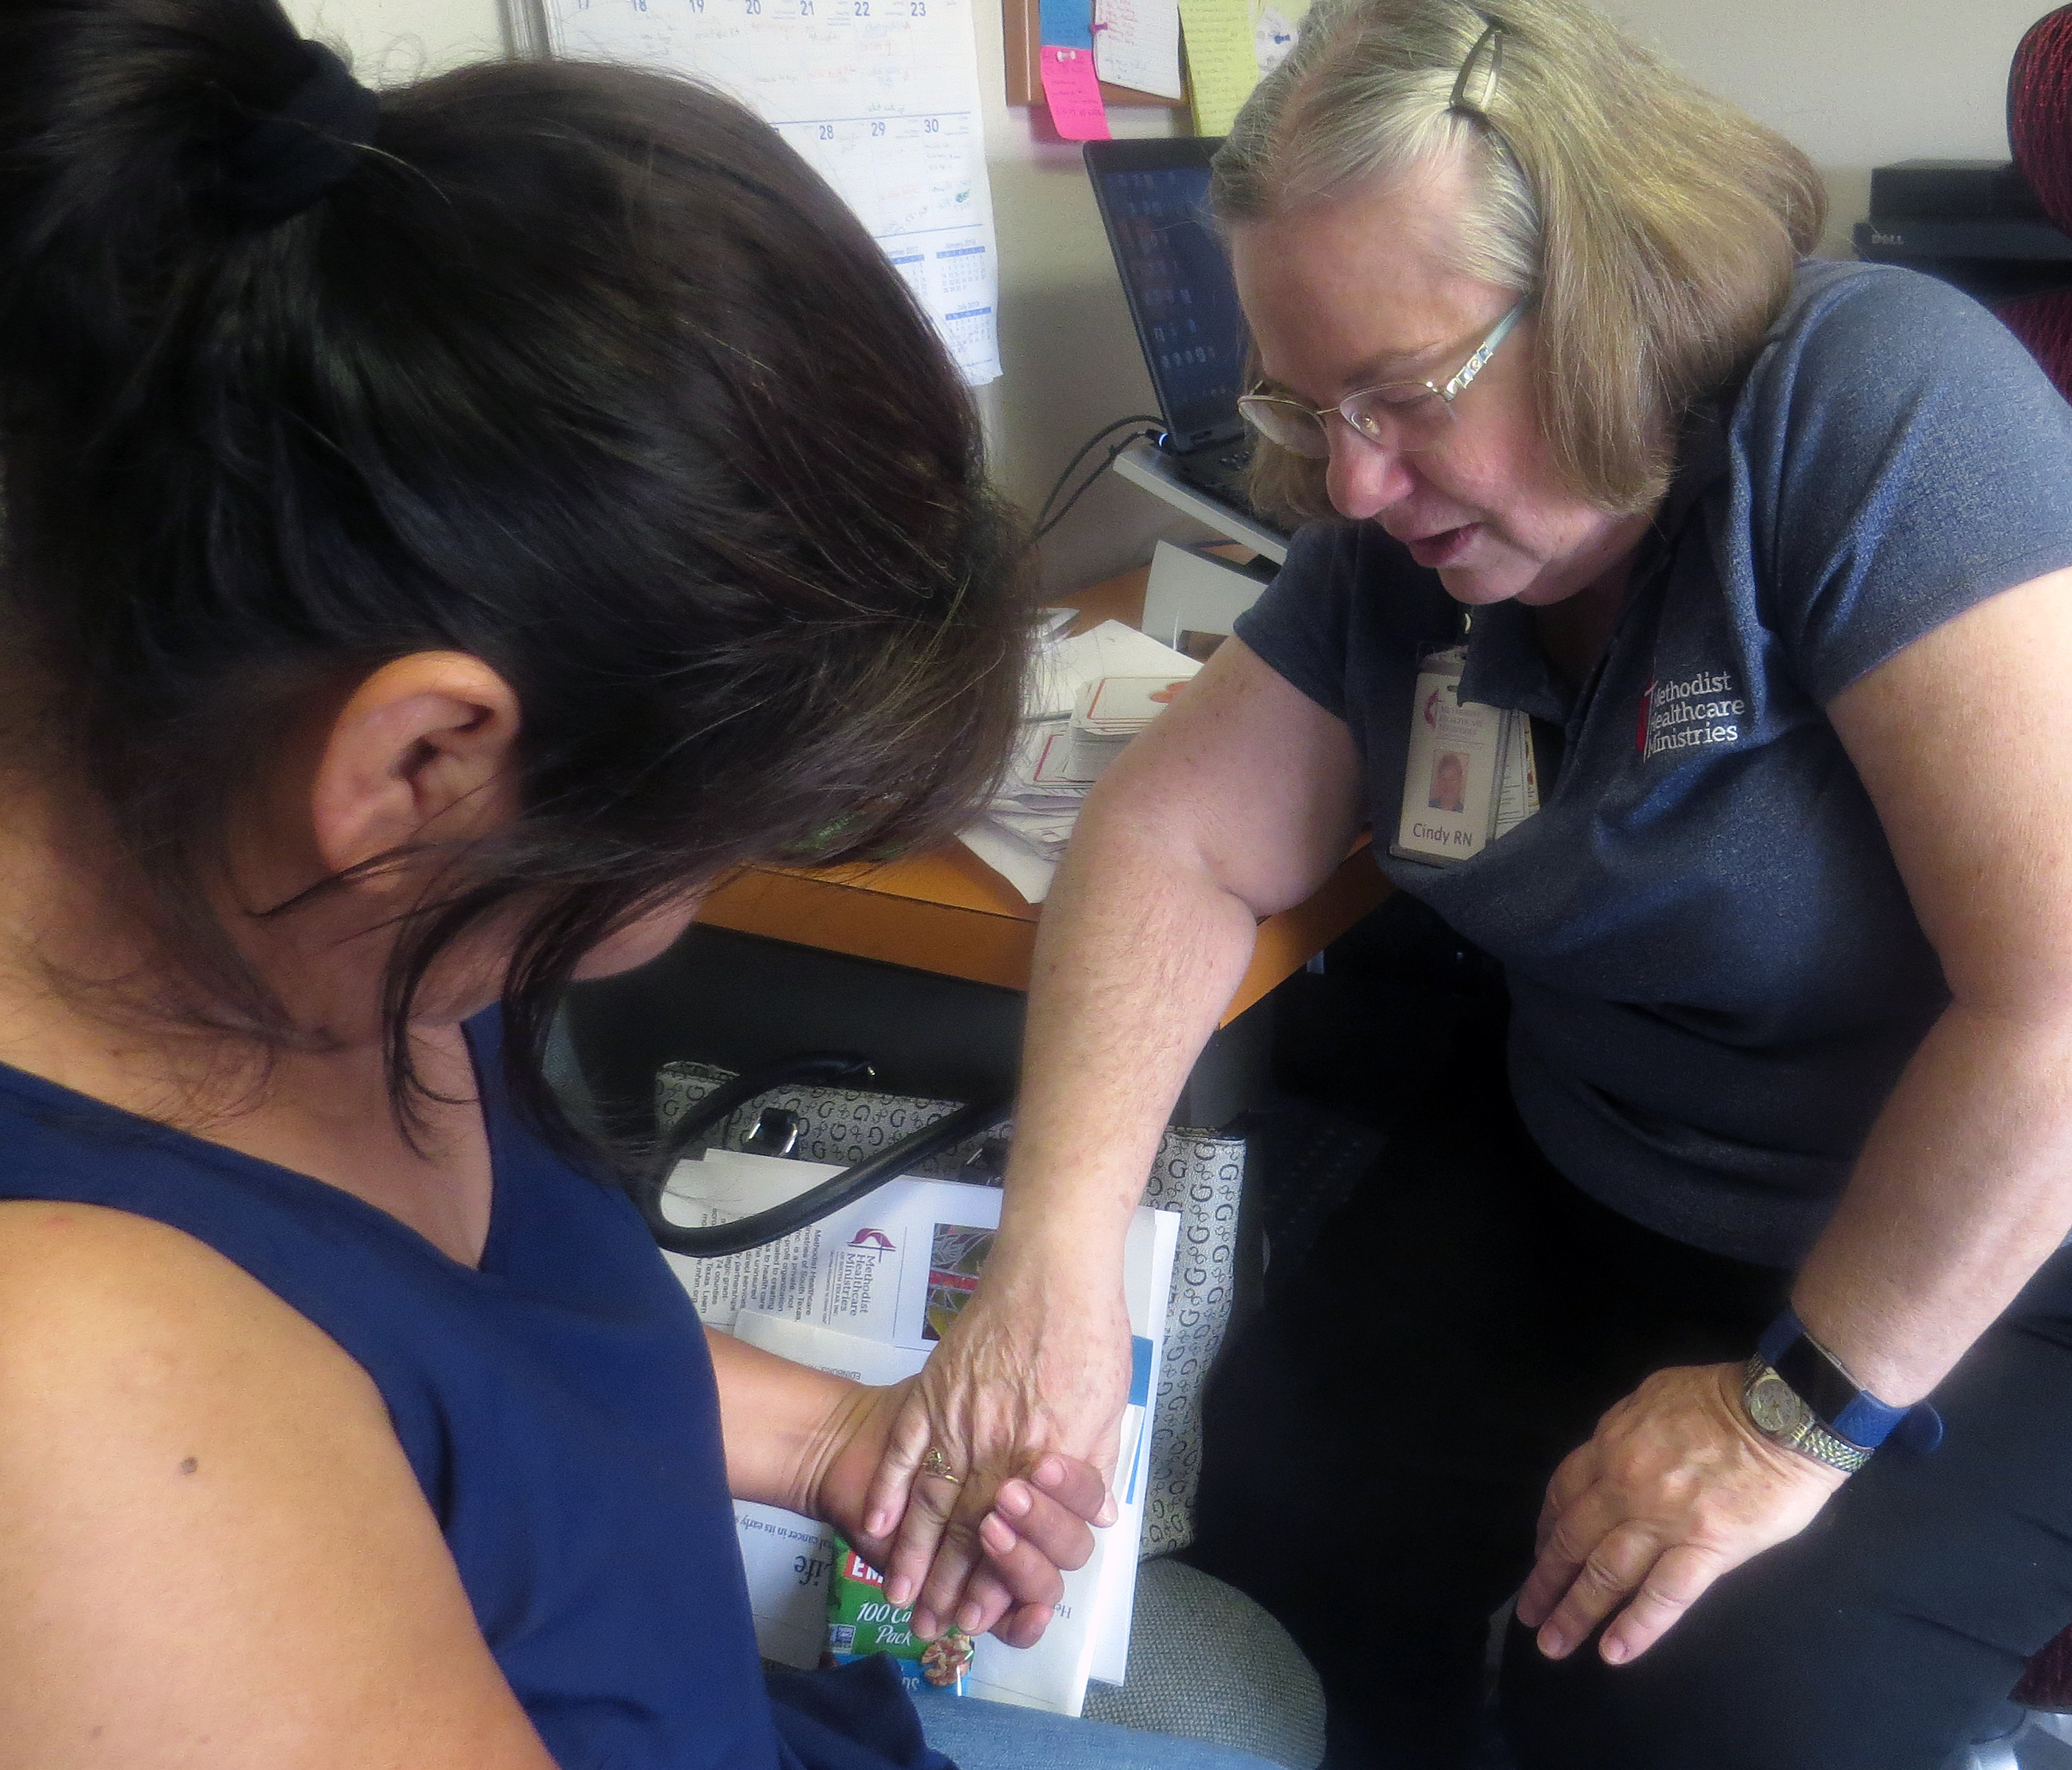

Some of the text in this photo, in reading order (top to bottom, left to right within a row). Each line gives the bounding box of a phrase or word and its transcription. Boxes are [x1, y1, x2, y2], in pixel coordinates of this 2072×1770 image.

[691, 0, 704, 13] 19
[746, 0, 761, 14] 20
[801, 1, 815, 15] 21
[854, 2, 870, 16] 22
[911, 2, 926, 16] 23
[819, 125, 834, 139] 28
[871, 122, 885, 137] 29
[924, 119, 939, 133] 30
[1412, 824, 1473, 847] Cindy RN
[751, 1259, 760, 1299] uninsured
[761, 1264, 769, 1289] health
[805, 1229, 821, 1315] Methodist Healthcare
[841, 1253, 855, 1311] Ministries
[711, 1271, 720, 1304] counties
[730, 1262, 740, 1311] partnerships
[777, 1262, 787, 1311] organization
[798, 1271, 806, 1294] South
[850, 1254, 865, 1316] Healthcare
[860, 1255, 875, 1313] Methodist
[701, 1291, 709, 1313] Learn
[767, 1278, 777, 1309] creating
[740, 1514, 764, 1533] early
[763, 1523, 775, 1536] its
[776, 1528, 786, 1539] in
[787, 1530, 817, 1544] cancer
[856, 1602, 891, 1622] 100
[876, 1625, 913, 1645] Pack
